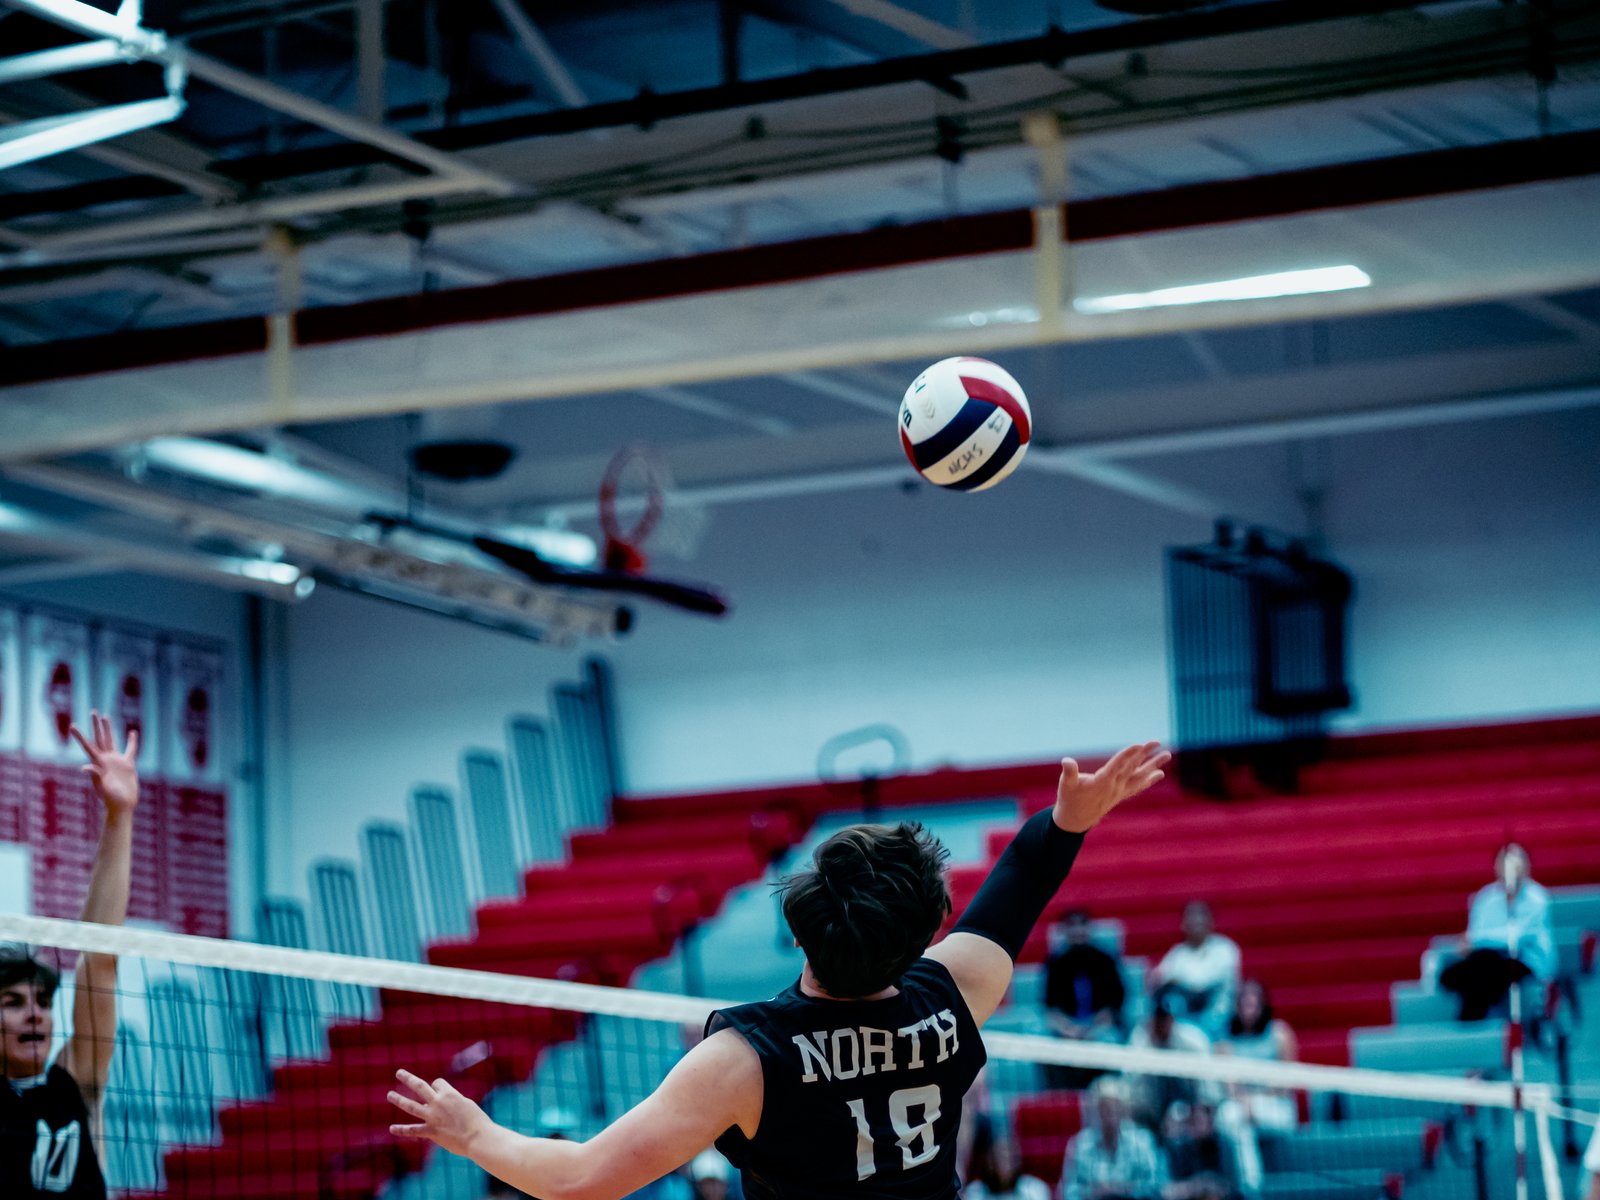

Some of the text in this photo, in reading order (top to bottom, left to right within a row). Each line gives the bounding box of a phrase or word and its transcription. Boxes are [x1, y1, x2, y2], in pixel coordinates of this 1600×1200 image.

[792, 1008, 959, 1083] NORTH
[30, 1118, 81, 1193] 10
[846, 1084, 942, 1181] 18
